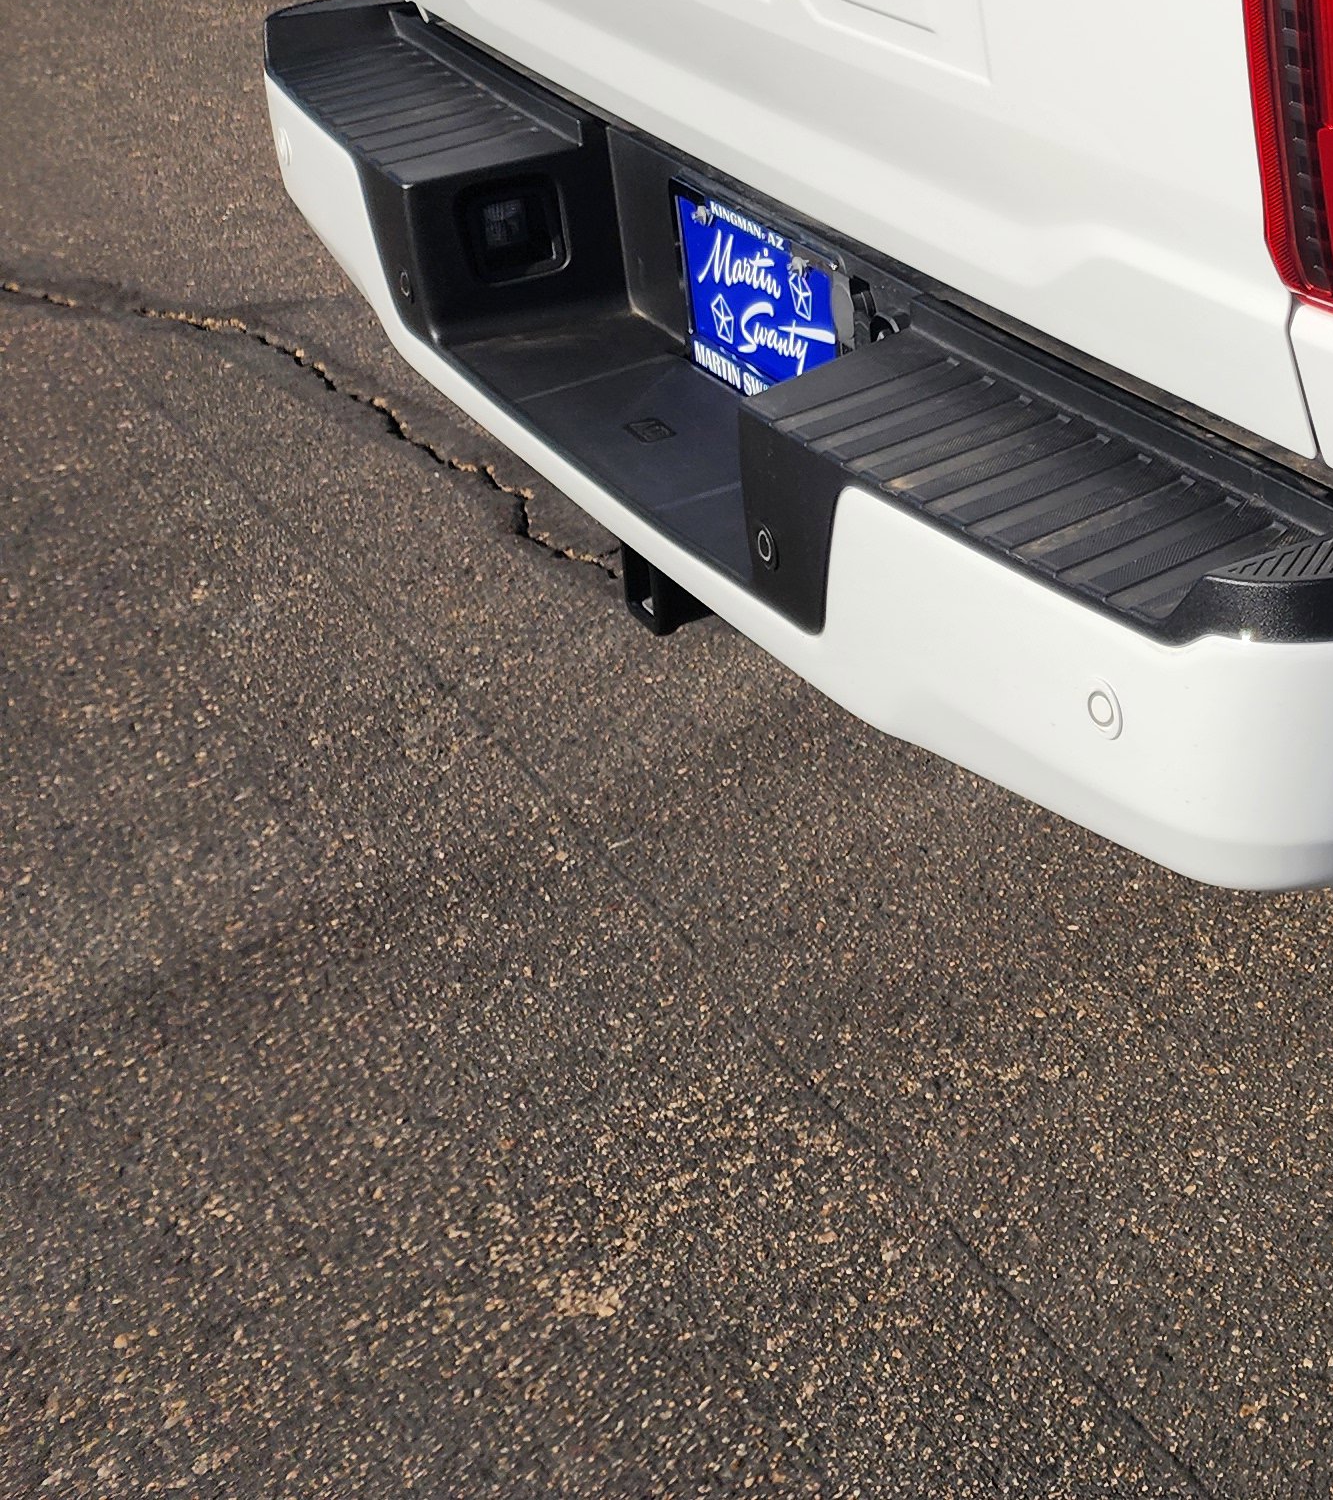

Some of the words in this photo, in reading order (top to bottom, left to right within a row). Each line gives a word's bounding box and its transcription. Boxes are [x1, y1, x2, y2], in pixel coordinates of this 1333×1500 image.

[697, 228, 781, 300] Martin
[767, 232, 785, 251] AZ
[693, 340, 742, 390] MARTIN
[738, 301, 836, 377] Swanty
